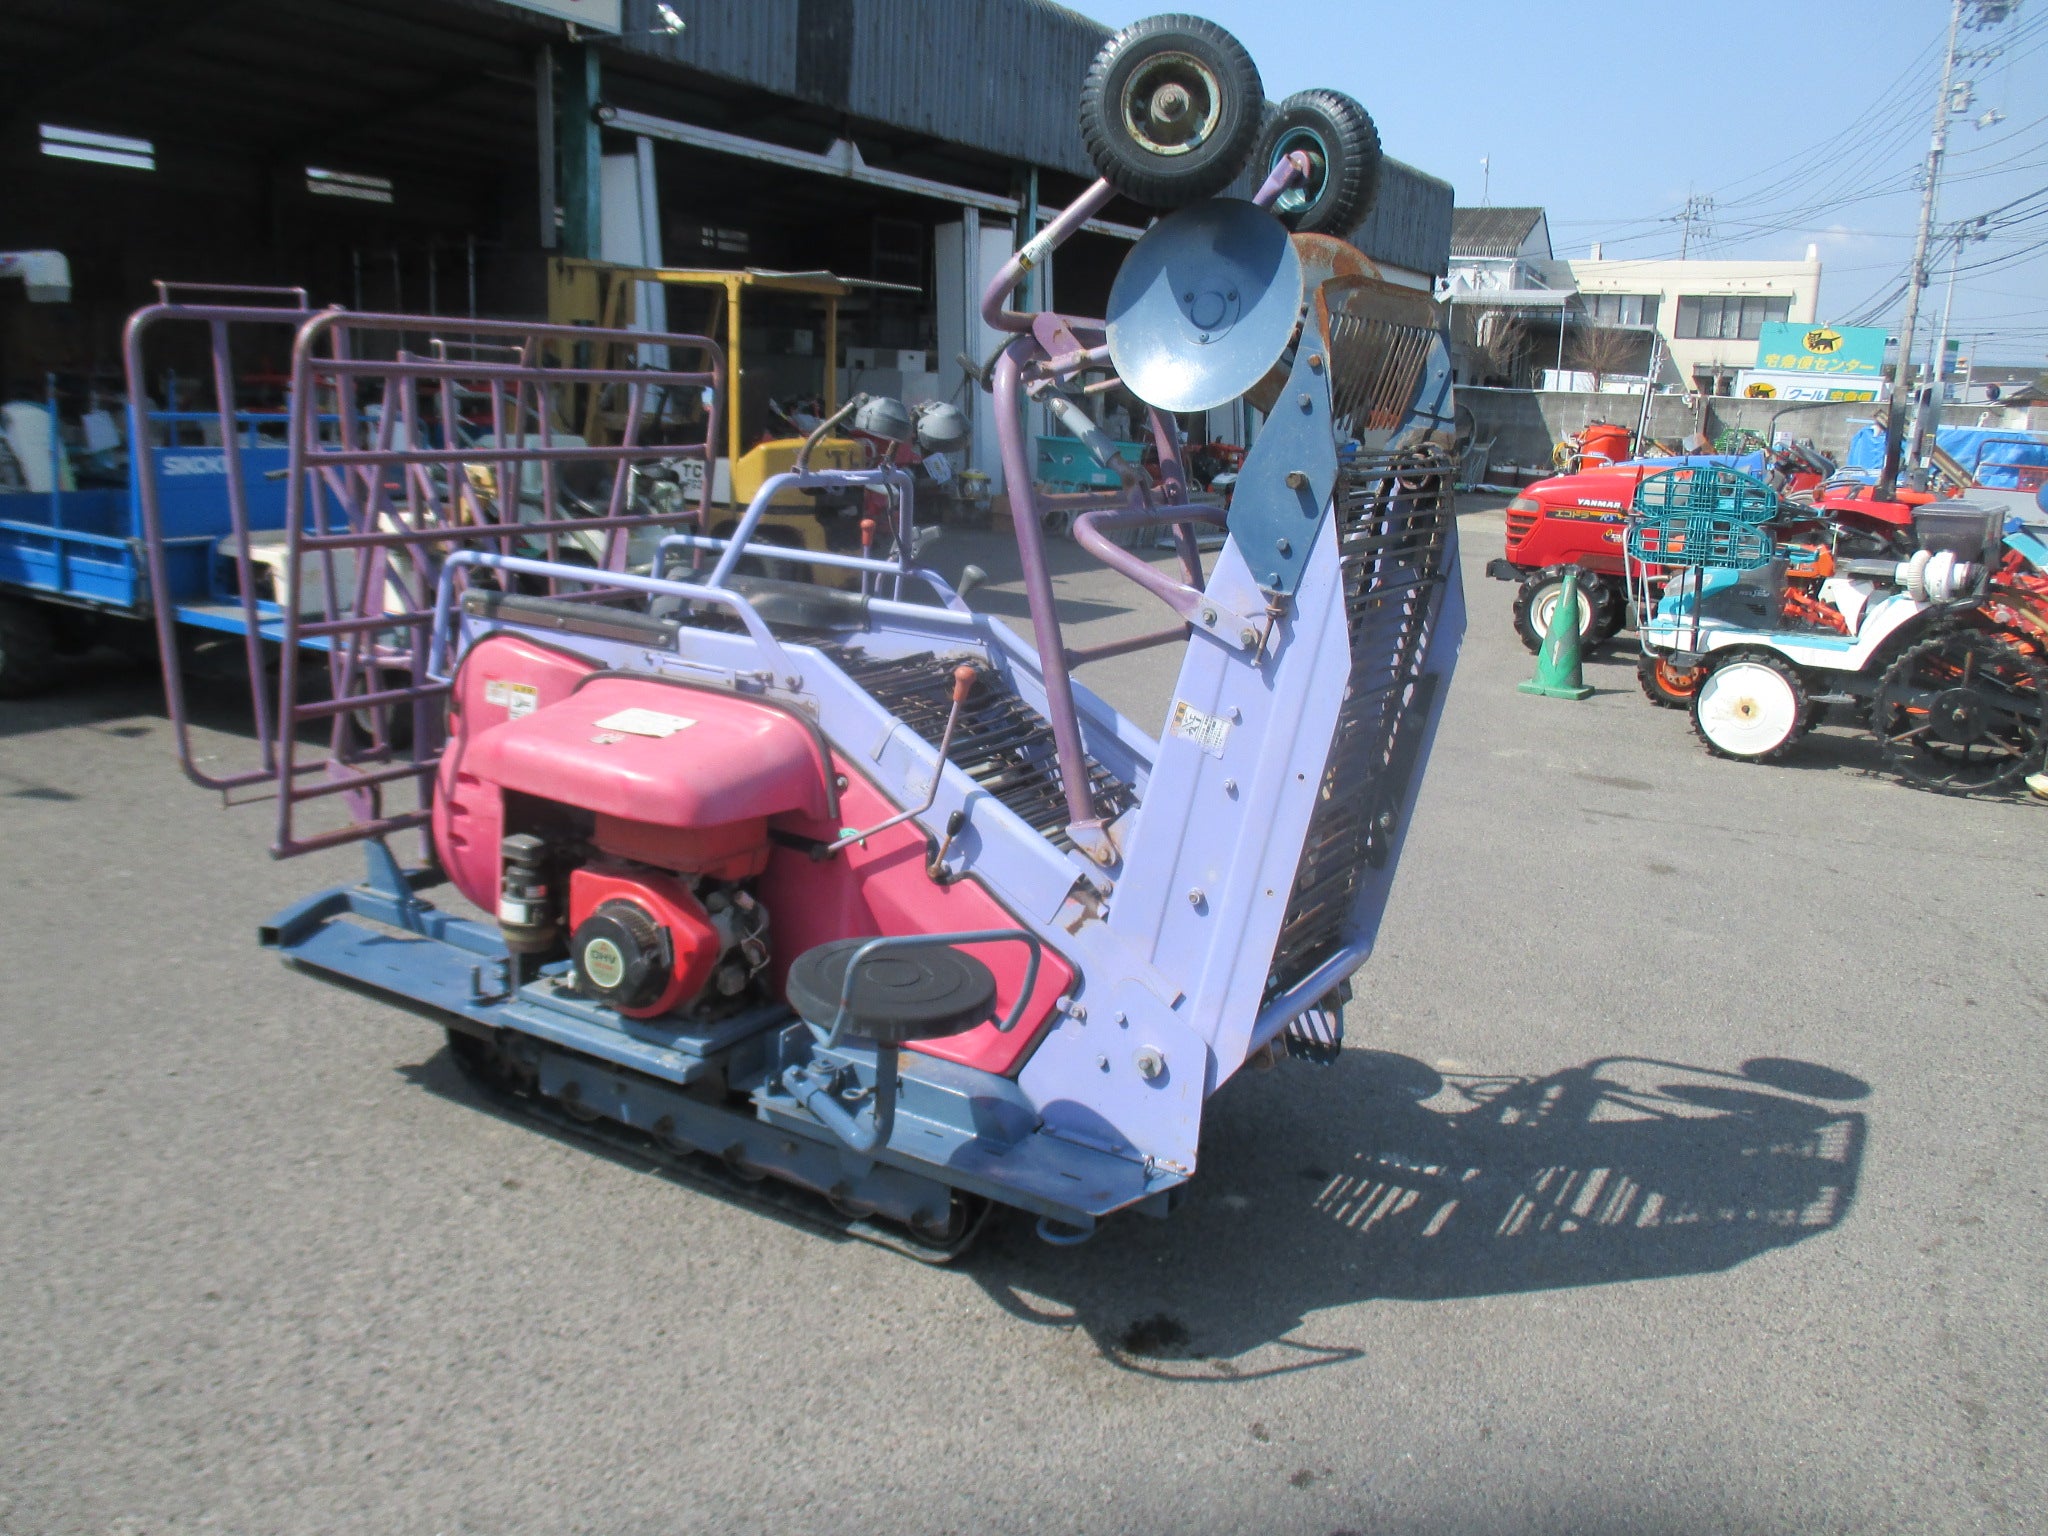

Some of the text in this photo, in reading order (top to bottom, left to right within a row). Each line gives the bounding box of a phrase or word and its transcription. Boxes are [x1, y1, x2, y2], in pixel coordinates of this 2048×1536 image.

[1764, 353, 1875, 373] 宅急便センター
[1577, 498, 1621, 509] YANMAR
